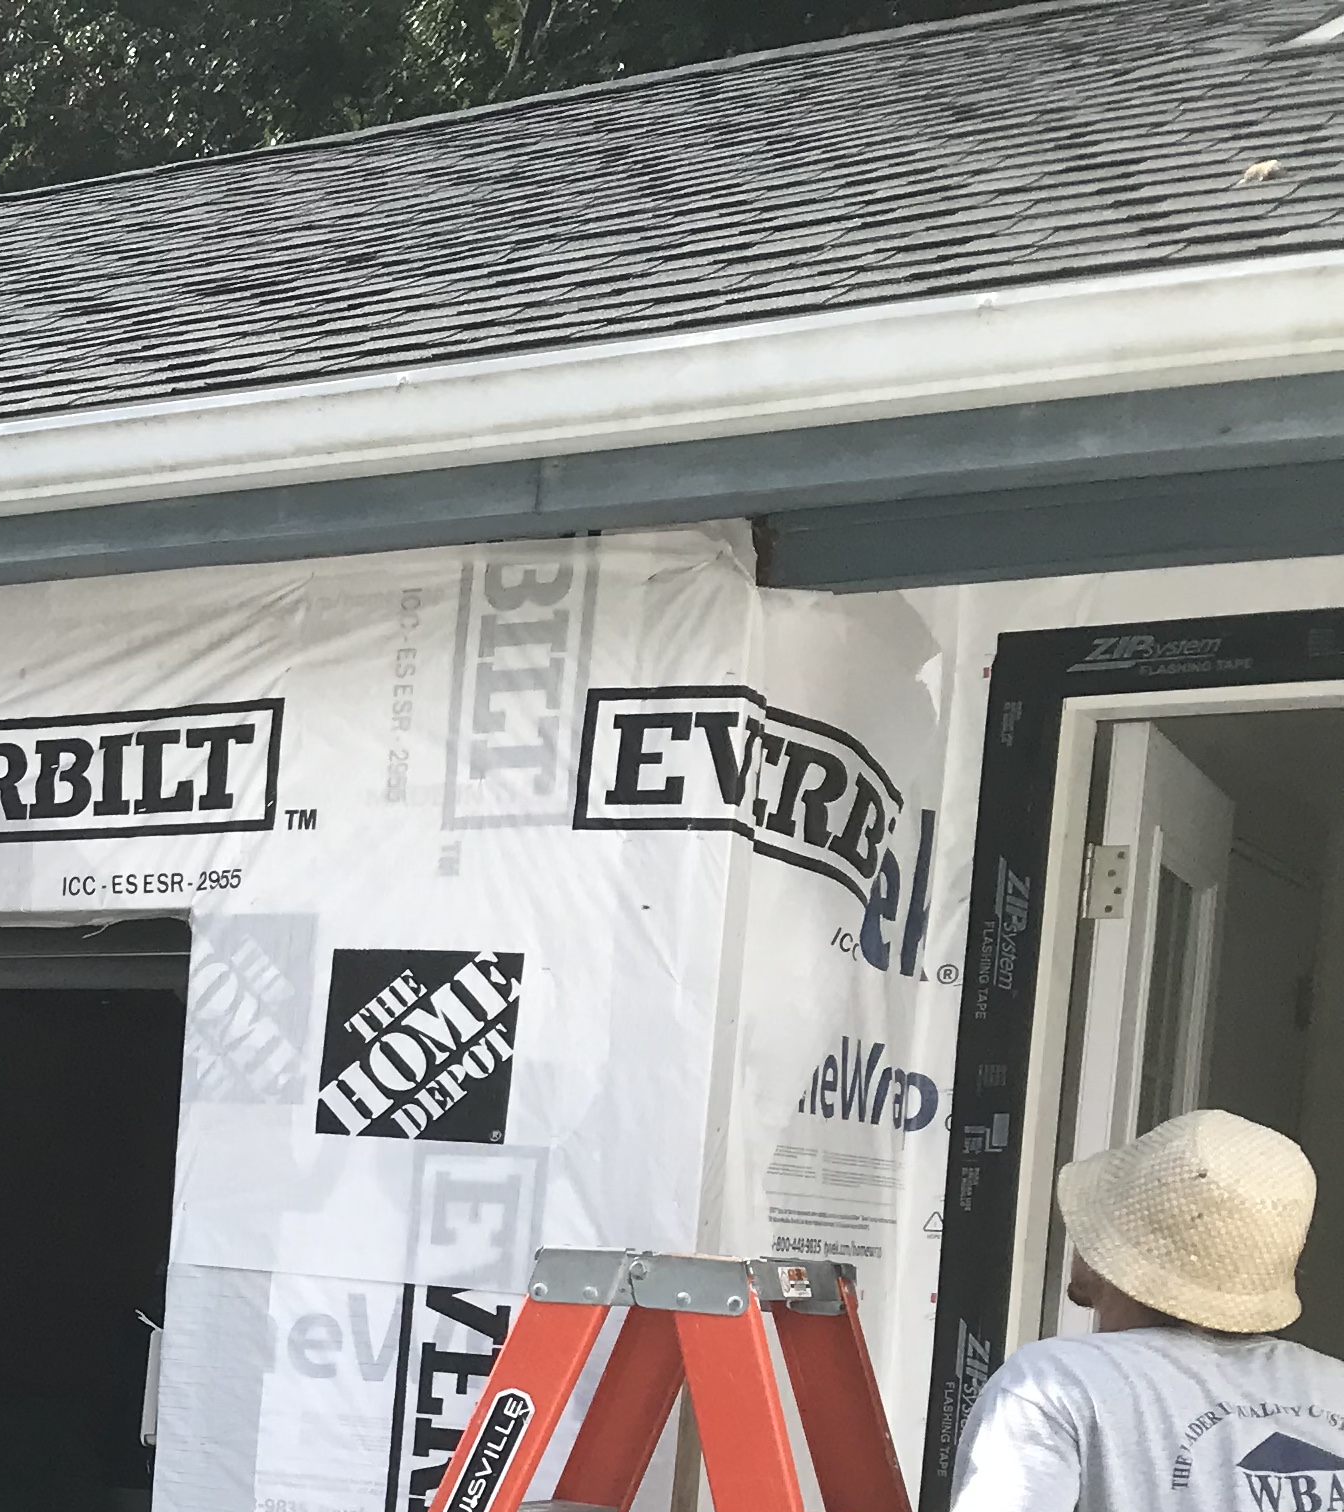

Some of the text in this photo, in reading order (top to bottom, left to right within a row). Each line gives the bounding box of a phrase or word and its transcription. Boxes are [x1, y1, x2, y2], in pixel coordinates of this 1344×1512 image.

[344, 969, 427, 1043] THE
[975, 920, 996, 1020] FLASHING TAPE
[318, 951, 521, 1136] HOME
[390, 1022, 515, 1140] DEPOT
[937, 1381, 956, 1478] FLASHING TAPE
